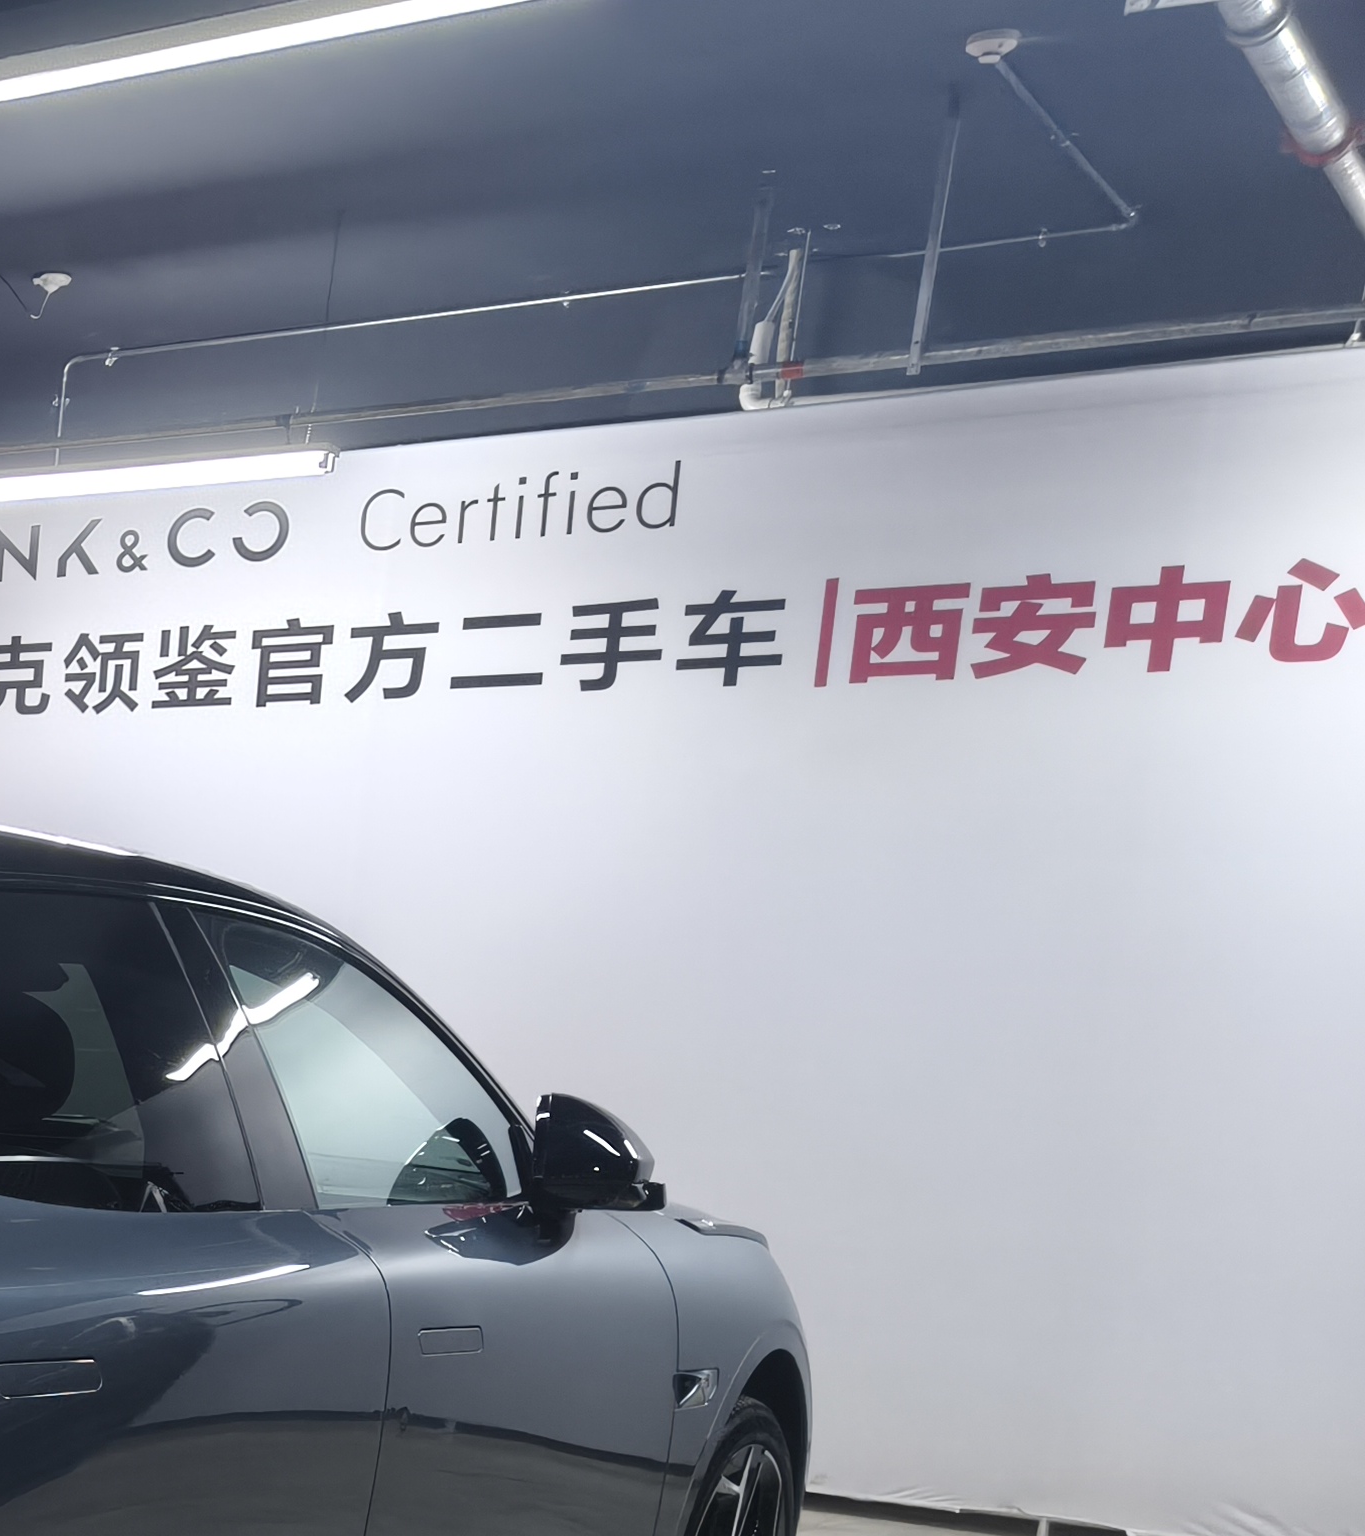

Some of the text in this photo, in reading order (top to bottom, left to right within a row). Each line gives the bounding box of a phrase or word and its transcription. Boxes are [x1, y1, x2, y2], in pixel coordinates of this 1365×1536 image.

[359, 460, 682, 552] Certified
[848, 557, 1365, 684] 西安中心
